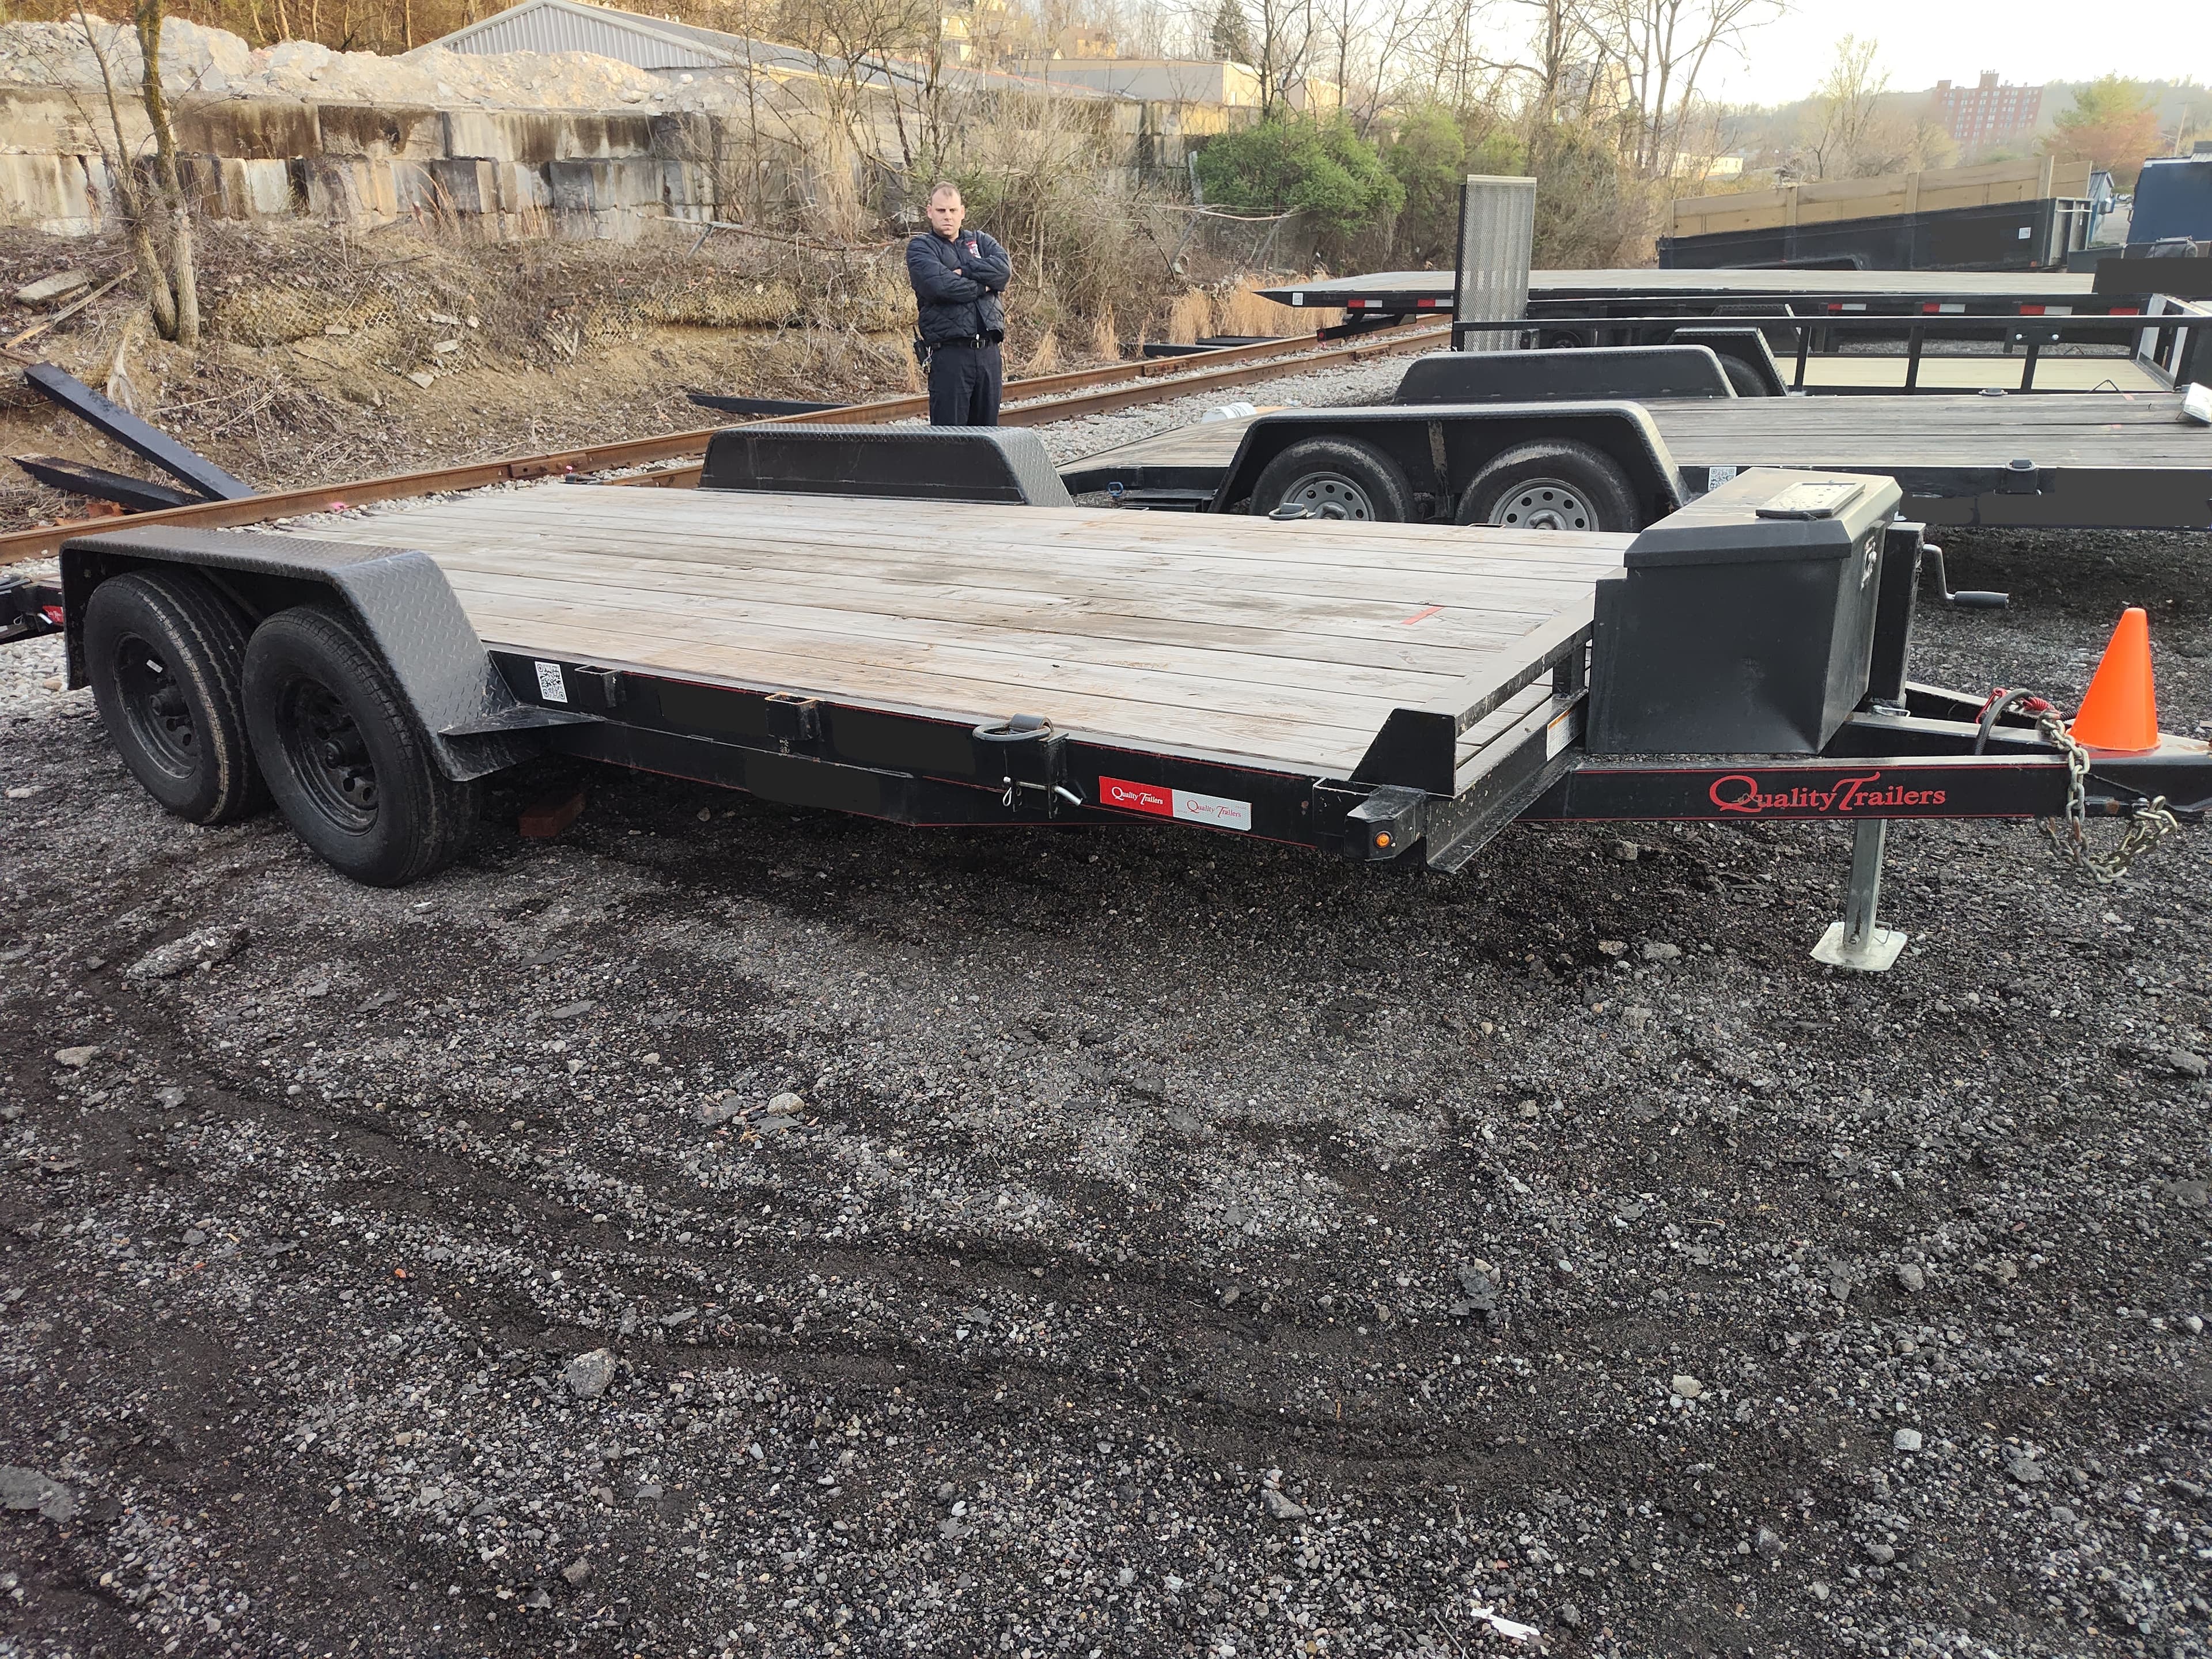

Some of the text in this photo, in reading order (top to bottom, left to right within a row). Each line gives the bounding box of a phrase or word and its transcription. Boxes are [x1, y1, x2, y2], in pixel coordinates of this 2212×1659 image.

[1111, 786, 1163, 805] Quality Trailers
[1710, 772, 1945, 812] Quality Trailers
[1187, 800, 1241, 818] Quality Trailers
